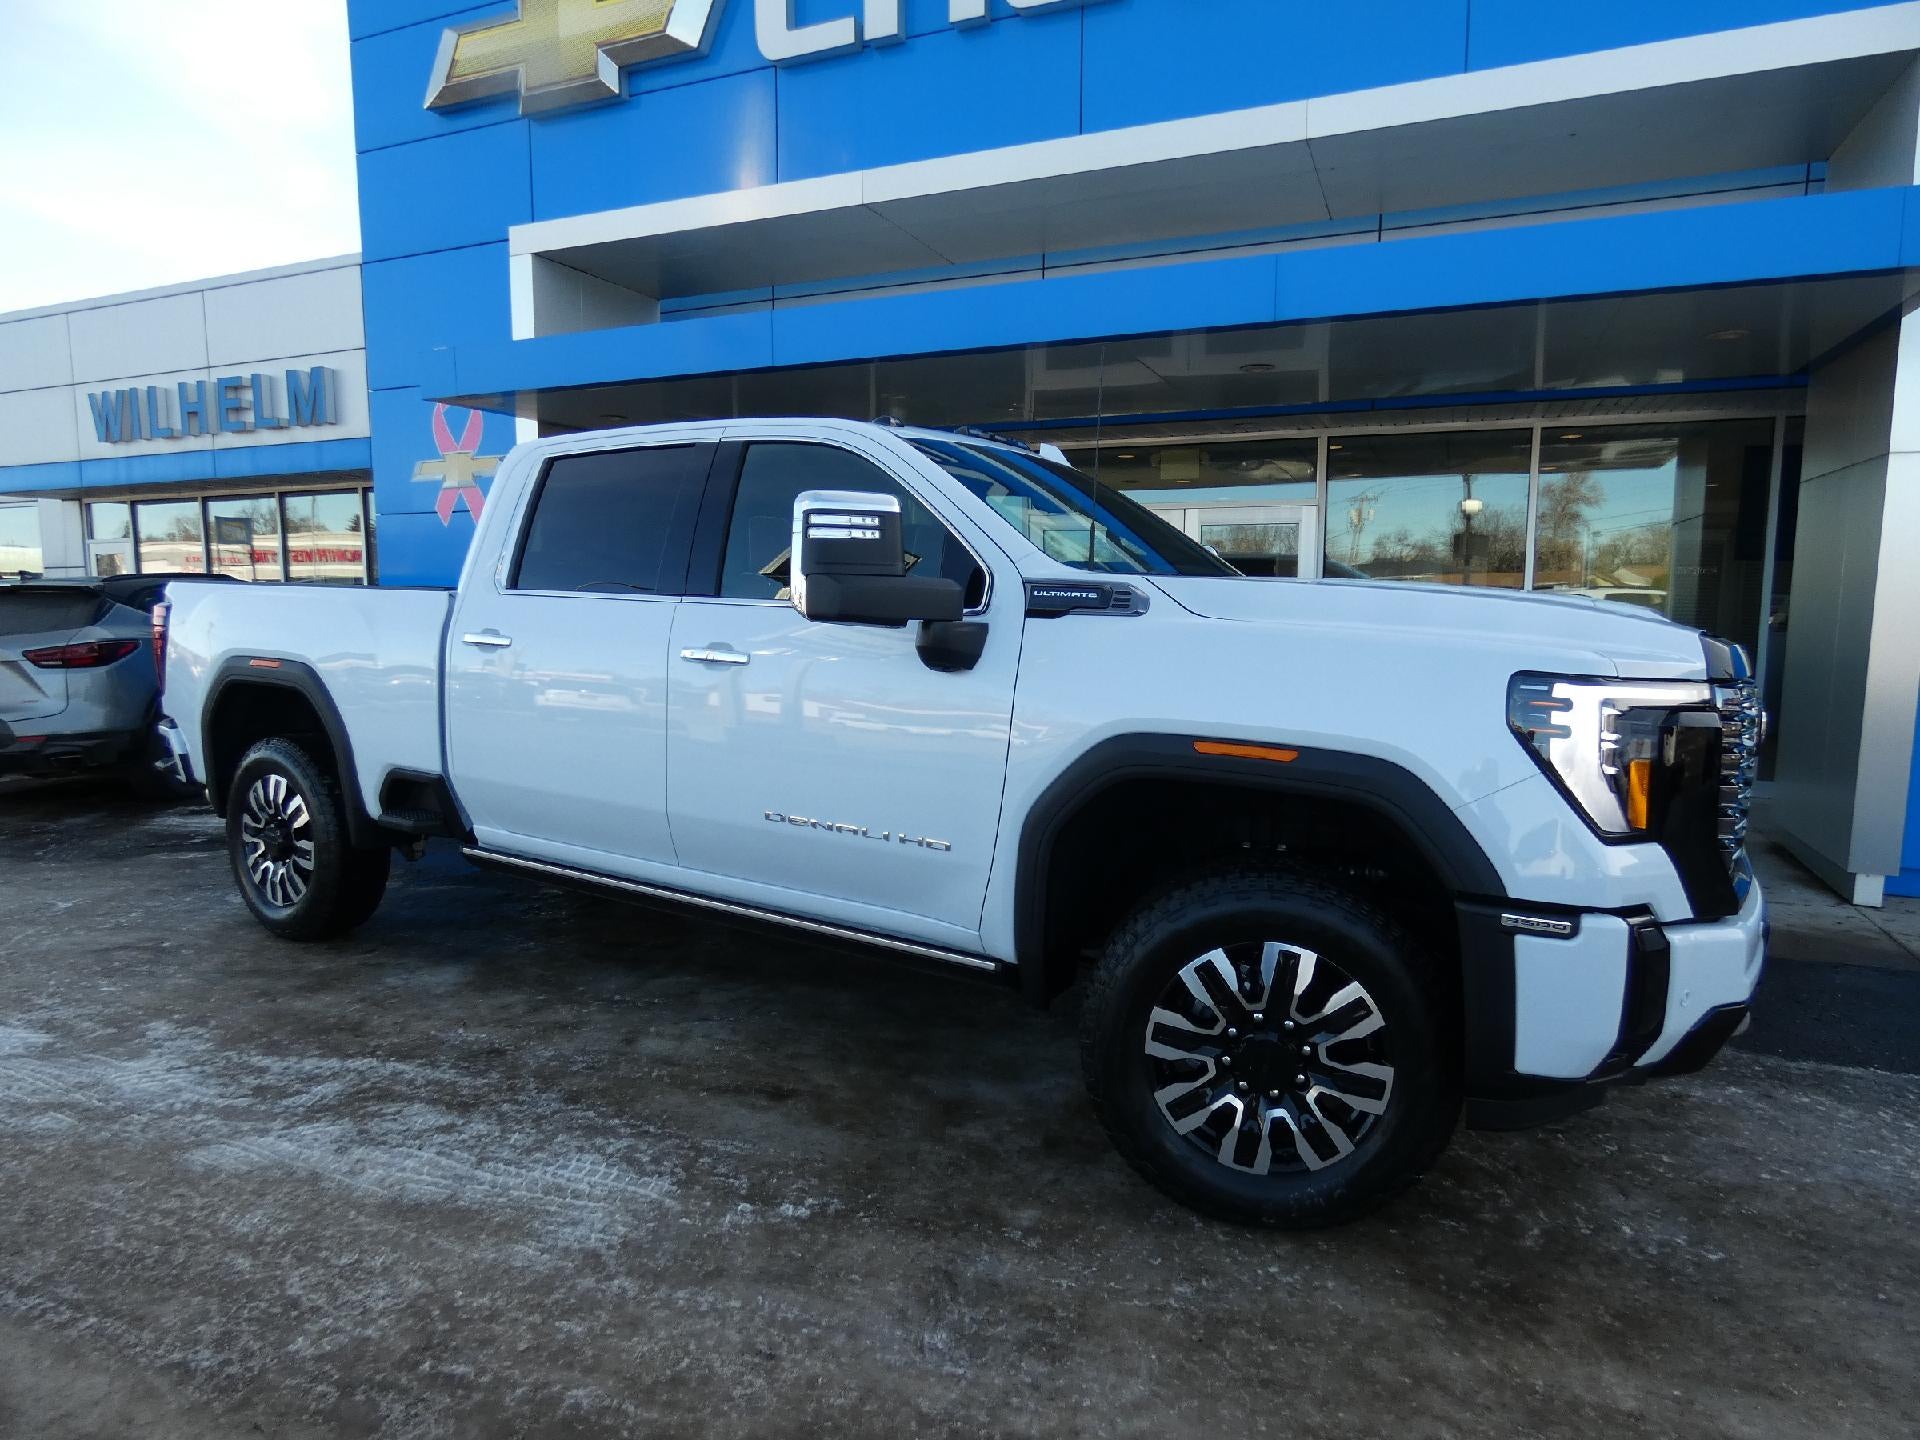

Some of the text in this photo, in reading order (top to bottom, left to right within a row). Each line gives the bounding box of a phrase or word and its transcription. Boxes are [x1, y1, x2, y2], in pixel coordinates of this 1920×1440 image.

[88, 366, 335, 443] WILHELM
[1033, 590, 1098, 598] ULTIMATE
[764, 810, 952, 852] DENALI HD
